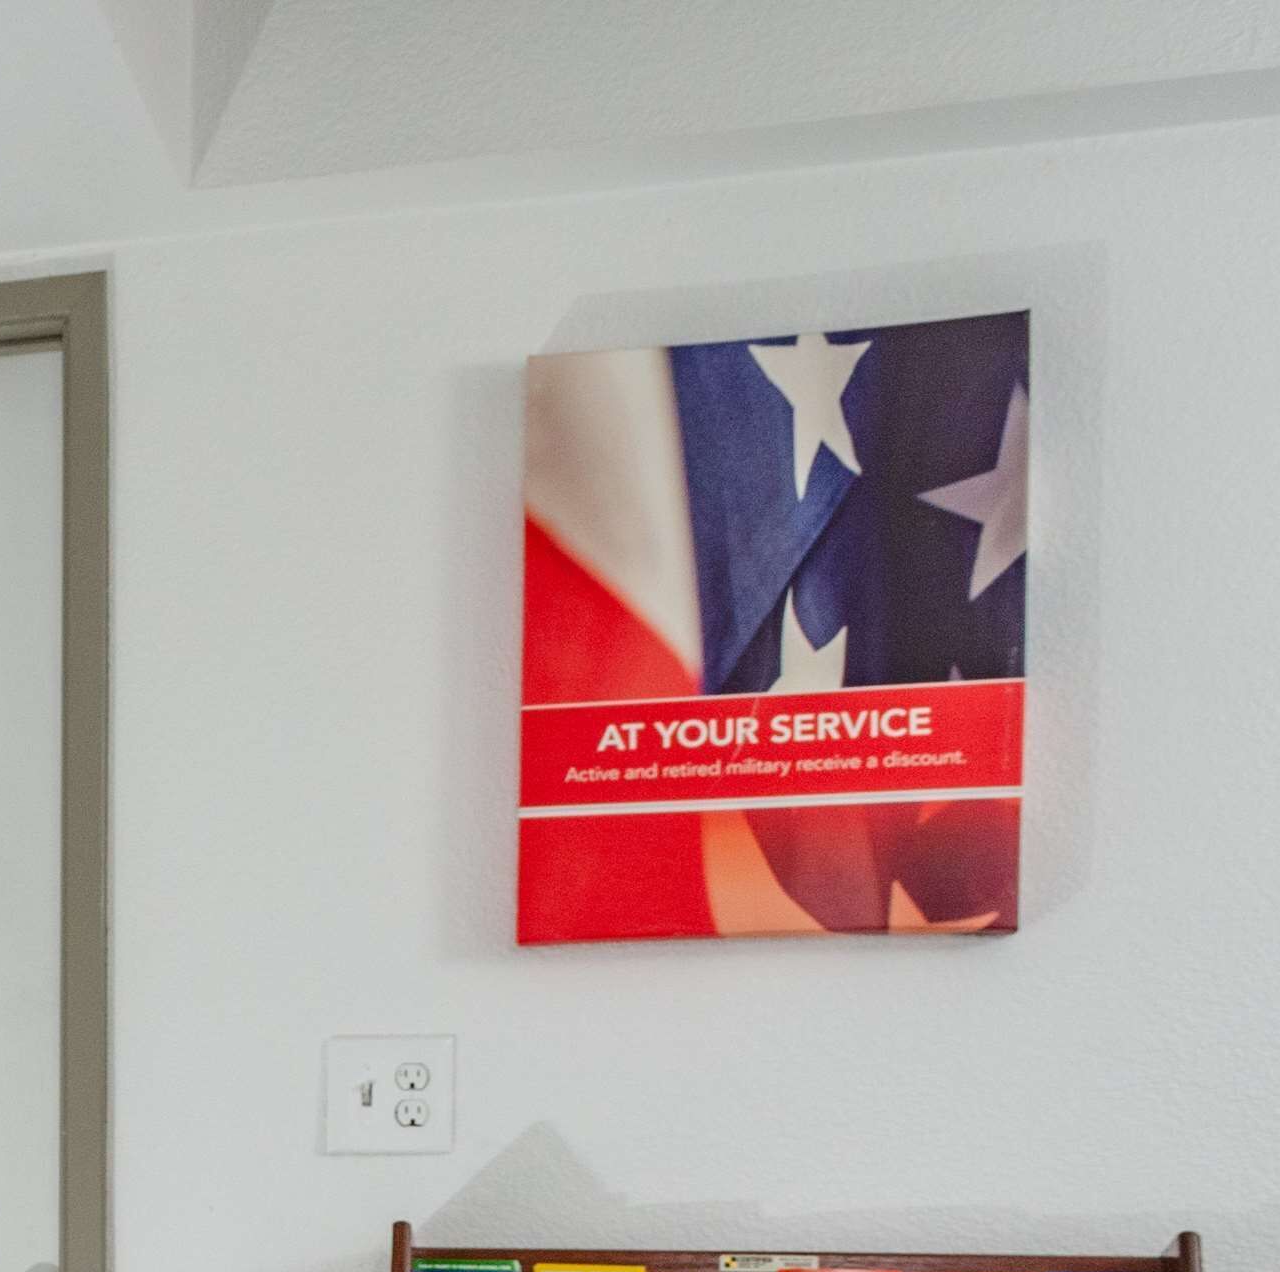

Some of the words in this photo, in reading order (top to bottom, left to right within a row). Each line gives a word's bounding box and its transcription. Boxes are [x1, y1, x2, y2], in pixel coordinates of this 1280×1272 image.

[596, 722, 646, 752] AT
[653, 716, 760, 750] YOUR
[770, 707, 933, 744] SERVICE
[564, 766, 620, 783] Active
[624, 762, 658, 780] and
[662, 758, 722, 779] retired
[725, 755, 791, 778] military
[795, 754, 862, 773] receive
[865, 756, 879, 769] a
[882, 750, 969, 768] discount.
